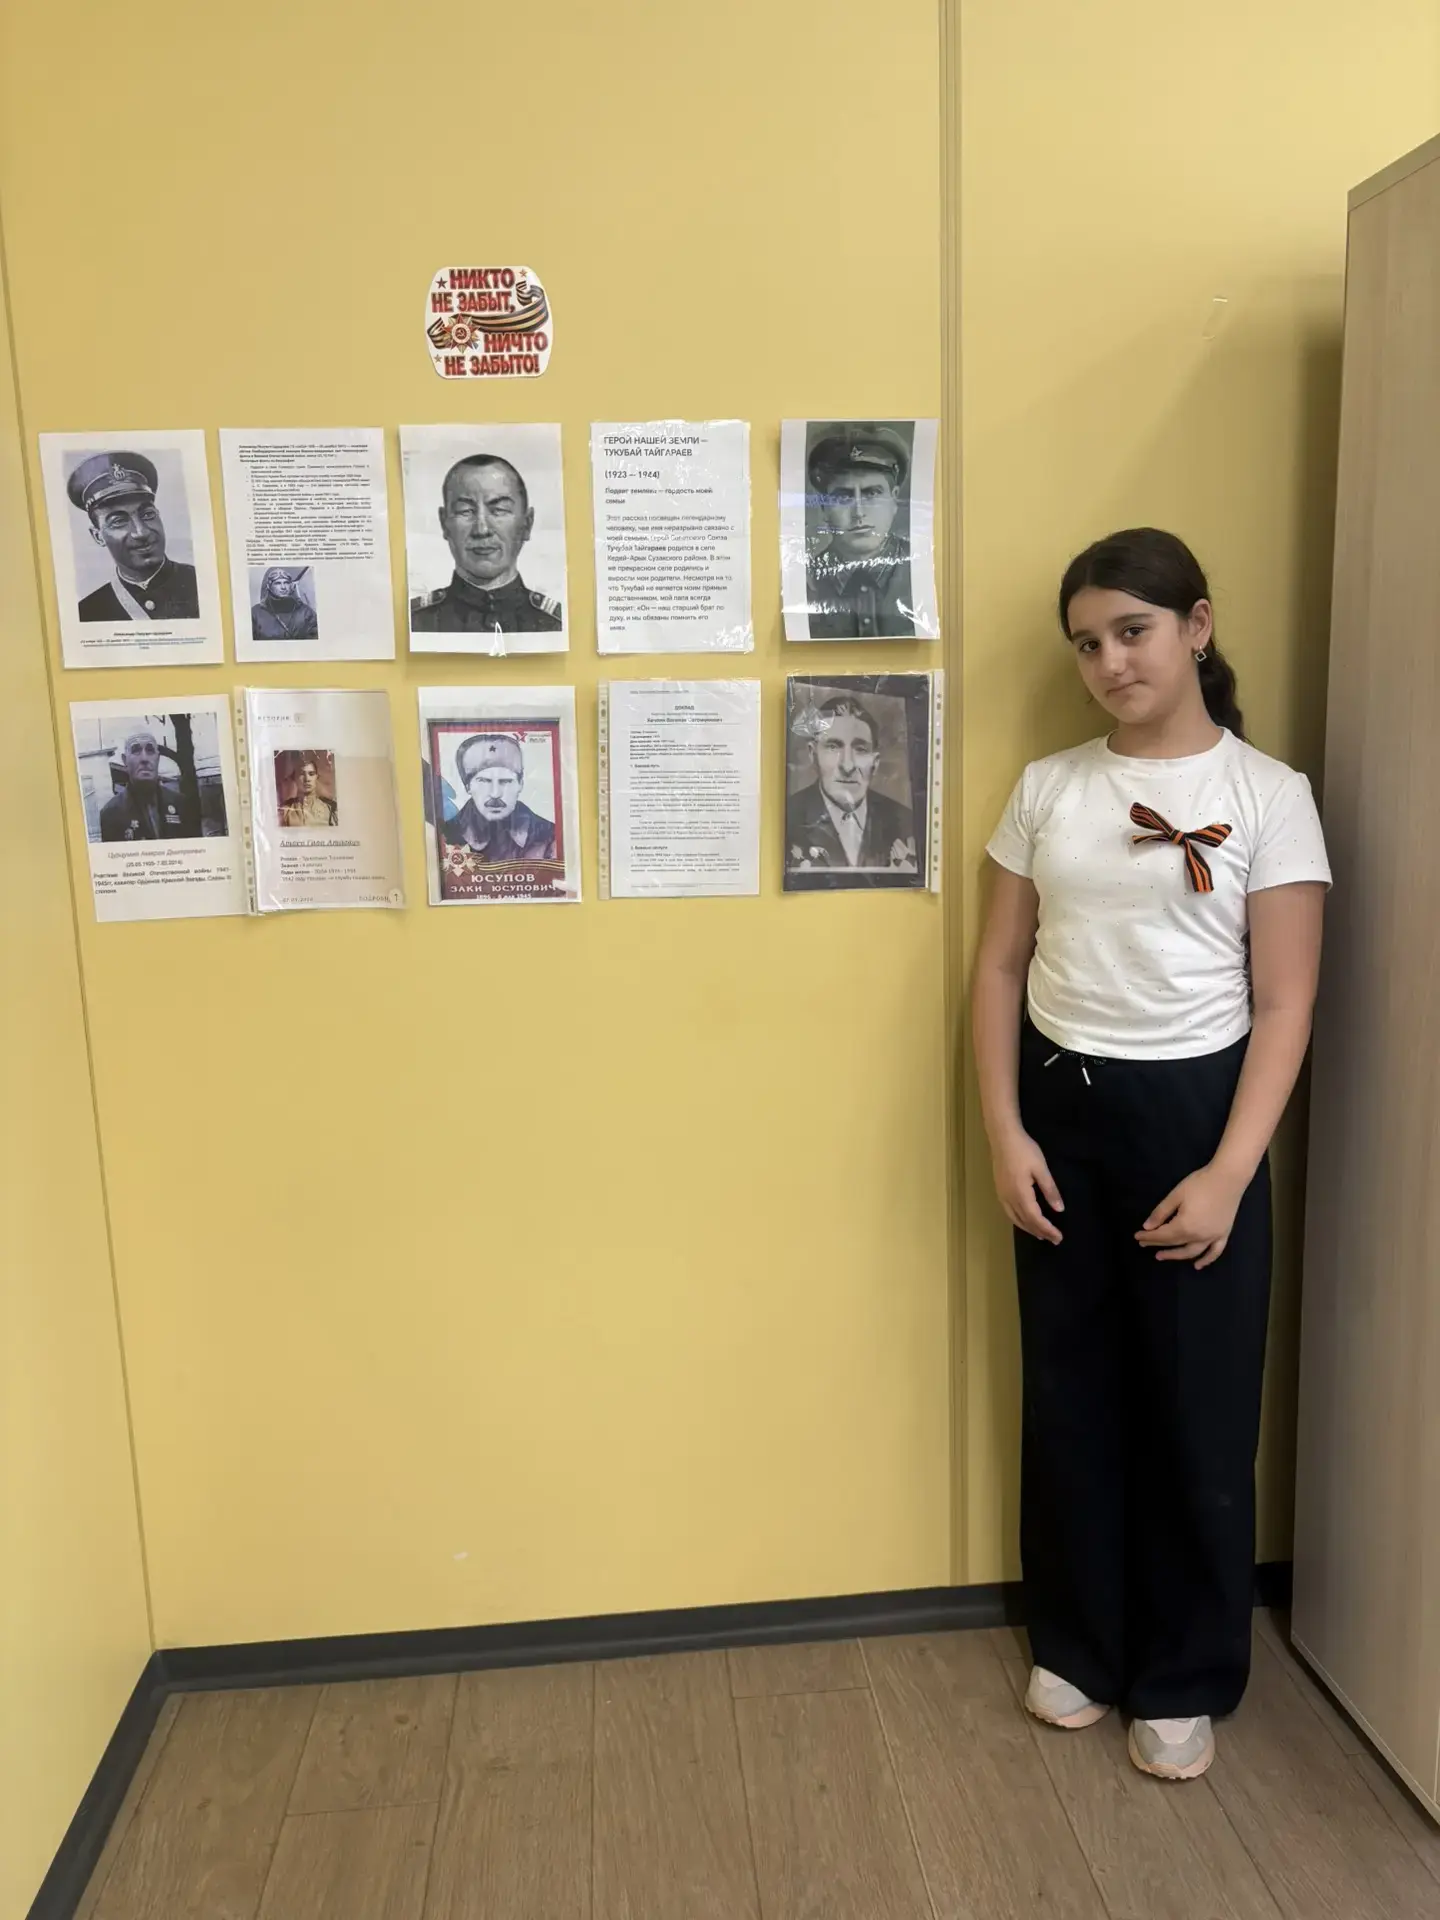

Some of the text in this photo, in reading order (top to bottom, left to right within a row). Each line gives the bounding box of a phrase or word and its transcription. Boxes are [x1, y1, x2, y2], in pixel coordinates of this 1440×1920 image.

[449, 268, 515, 289] НИКТО
[431, 291, 515, 313] НЕ ЗАБЫТ,
[484, 332, 548, 353] НИЧТО
[444, 354, 539, 376] НЕ ЗАБЫТО!
[604, 435, 632, 444] ГЕРОЙ
[634, 436, 666, 444] НАШЕЙ
[669, 436, 699, 444] ЗЕМЛИ
[604, 448, 692, 456] ТУКУБАЙ ТАЙГАРАЕВ
[605, 470, 626, 479] (1923
[638, 470, 660, 479] 1944)
[471, 874, 535, 883] ЮСУПОВ
[492, 884, 556, 892] ЮСУПОВИЧ
